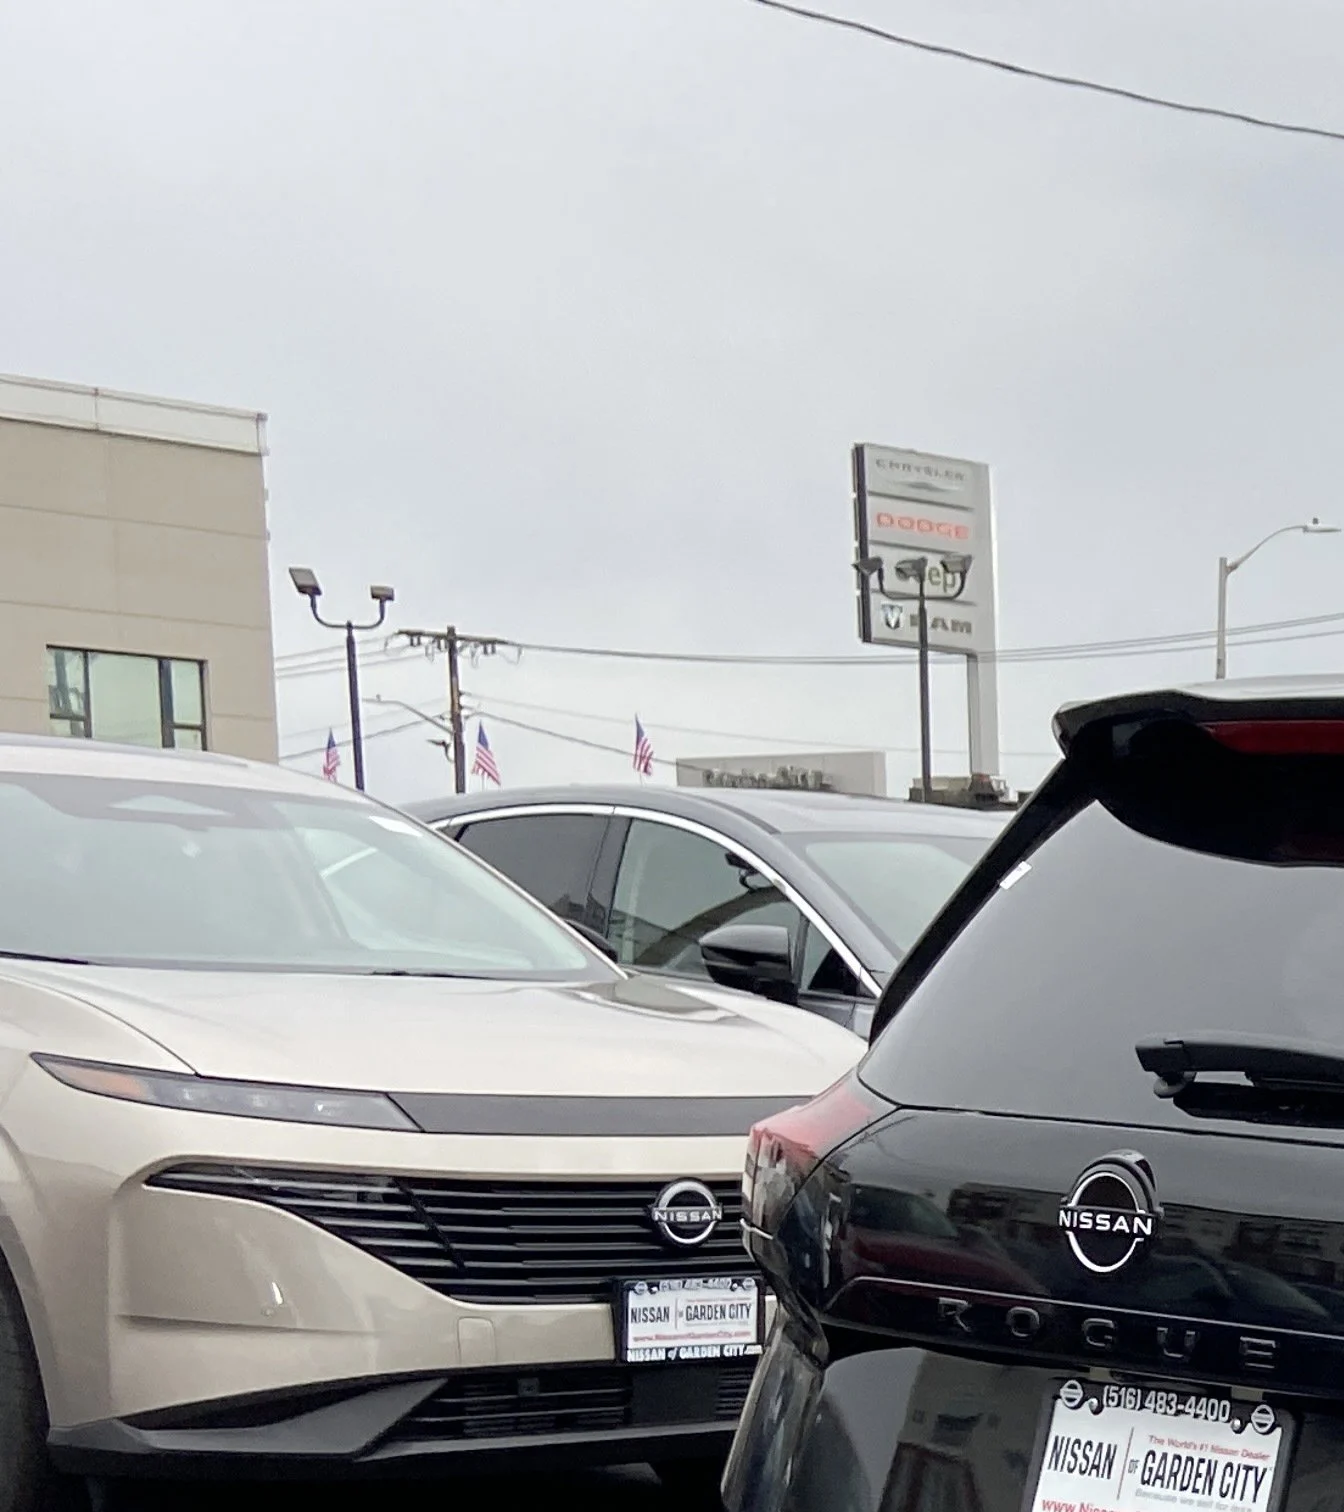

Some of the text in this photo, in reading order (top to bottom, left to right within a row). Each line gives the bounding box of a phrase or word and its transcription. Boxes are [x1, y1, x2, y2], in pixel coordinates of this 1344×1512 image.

[876, 511, 970, 540] DODGE
[653, 1208, 723, 1222] NISSAN
[1058, 1209, 1153, 1236] NISSAN
[630, 1305, 670, 1324] NISSAN
[685, 1303, 727, 1322] GARDEN
[728, 1302, 753, 1319] CITY
[938, 1297, 1277, 1369] ROGUE
[627, 1347, 666, 1362] NISSAN
[679, 1346, 721, 1360] GARDEN
[1102, 1385, 1231, 1424] (516) 483-4400
[1046, 1435, 1118, 1480] NISSAN
[1148, 1434, 1165, 1446] The
[1240, 1448, 1271, 1463] Dealer
[1127, 1449, 1268, 1504] OF GARDEN CITY
